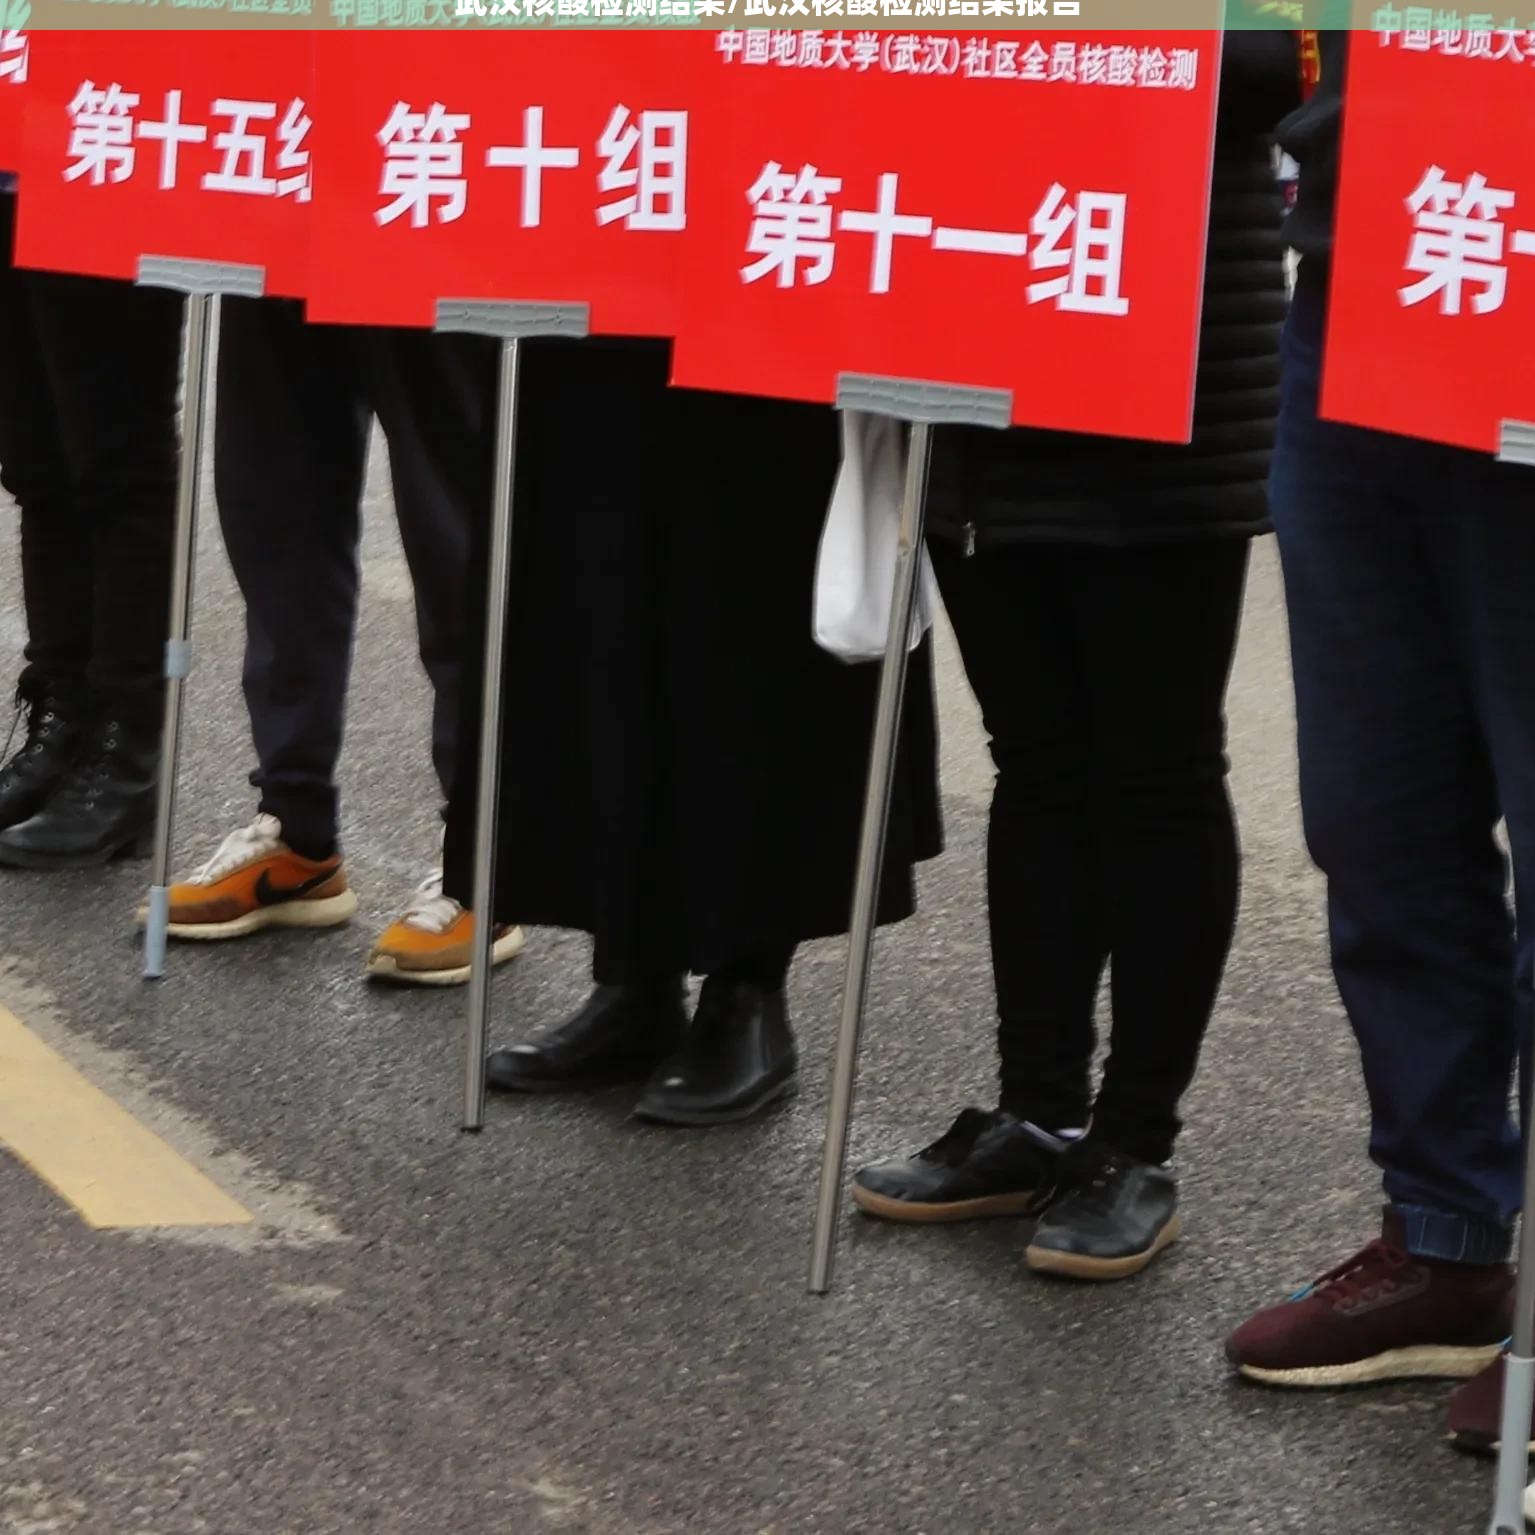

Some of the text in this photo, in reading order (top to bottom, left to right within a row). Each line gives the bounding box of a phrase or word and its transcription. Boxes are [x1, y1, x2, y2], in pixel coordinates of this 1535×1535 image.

[716, 25, 1199, 91] 中国地质大学(武汉)社区全员核酸检测
[374, 100, 689, 231] 第十组
[740, 160, 1130, 316] 第十一组
